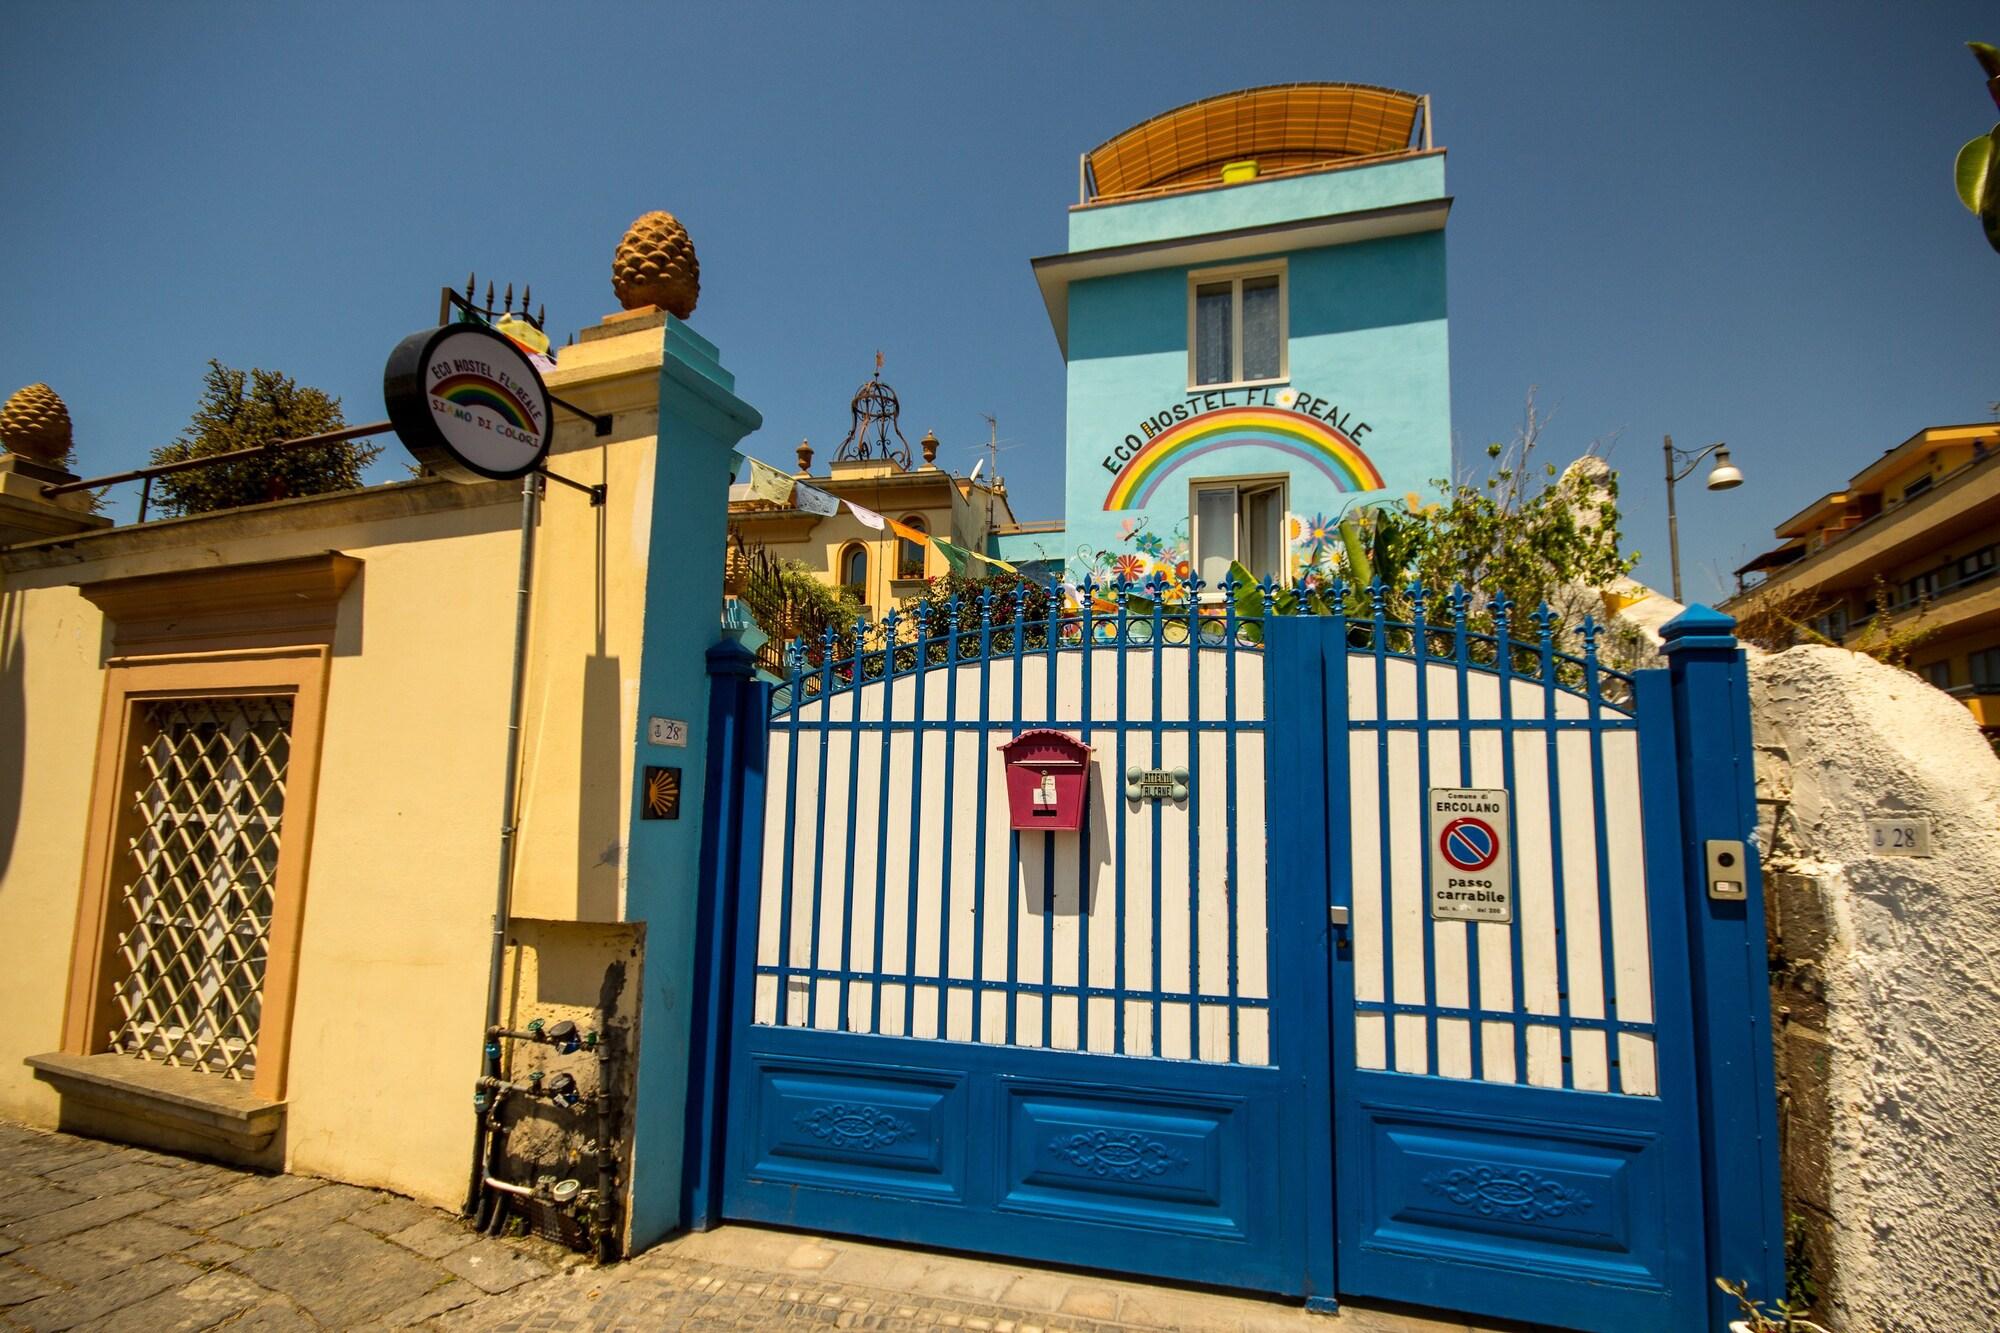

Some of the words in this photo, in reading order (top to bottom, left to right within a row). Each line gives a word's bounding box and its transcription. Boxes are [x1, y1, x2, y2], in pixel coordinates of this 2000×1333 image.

[431, 361, 452, 380] ECO
[453, 359, 493, 378] HOSTEL
[432, 399, 472, 423] SIAMO
[478, 416, 492, 431] DI
[496, 424, 539, 448] COLORI
[1102, 434, 1143, 476] ECO
[1140, 390, 1236, 440] HOSTEL
[666, 725, 679, 740] 28
[1436, 802, 1500, 813] ERCOLANO
[1893, 828, 1915, 847] 28
[1448, 878, 1492, 889] passo
[1437, 891, 1505, 903] carrabile
